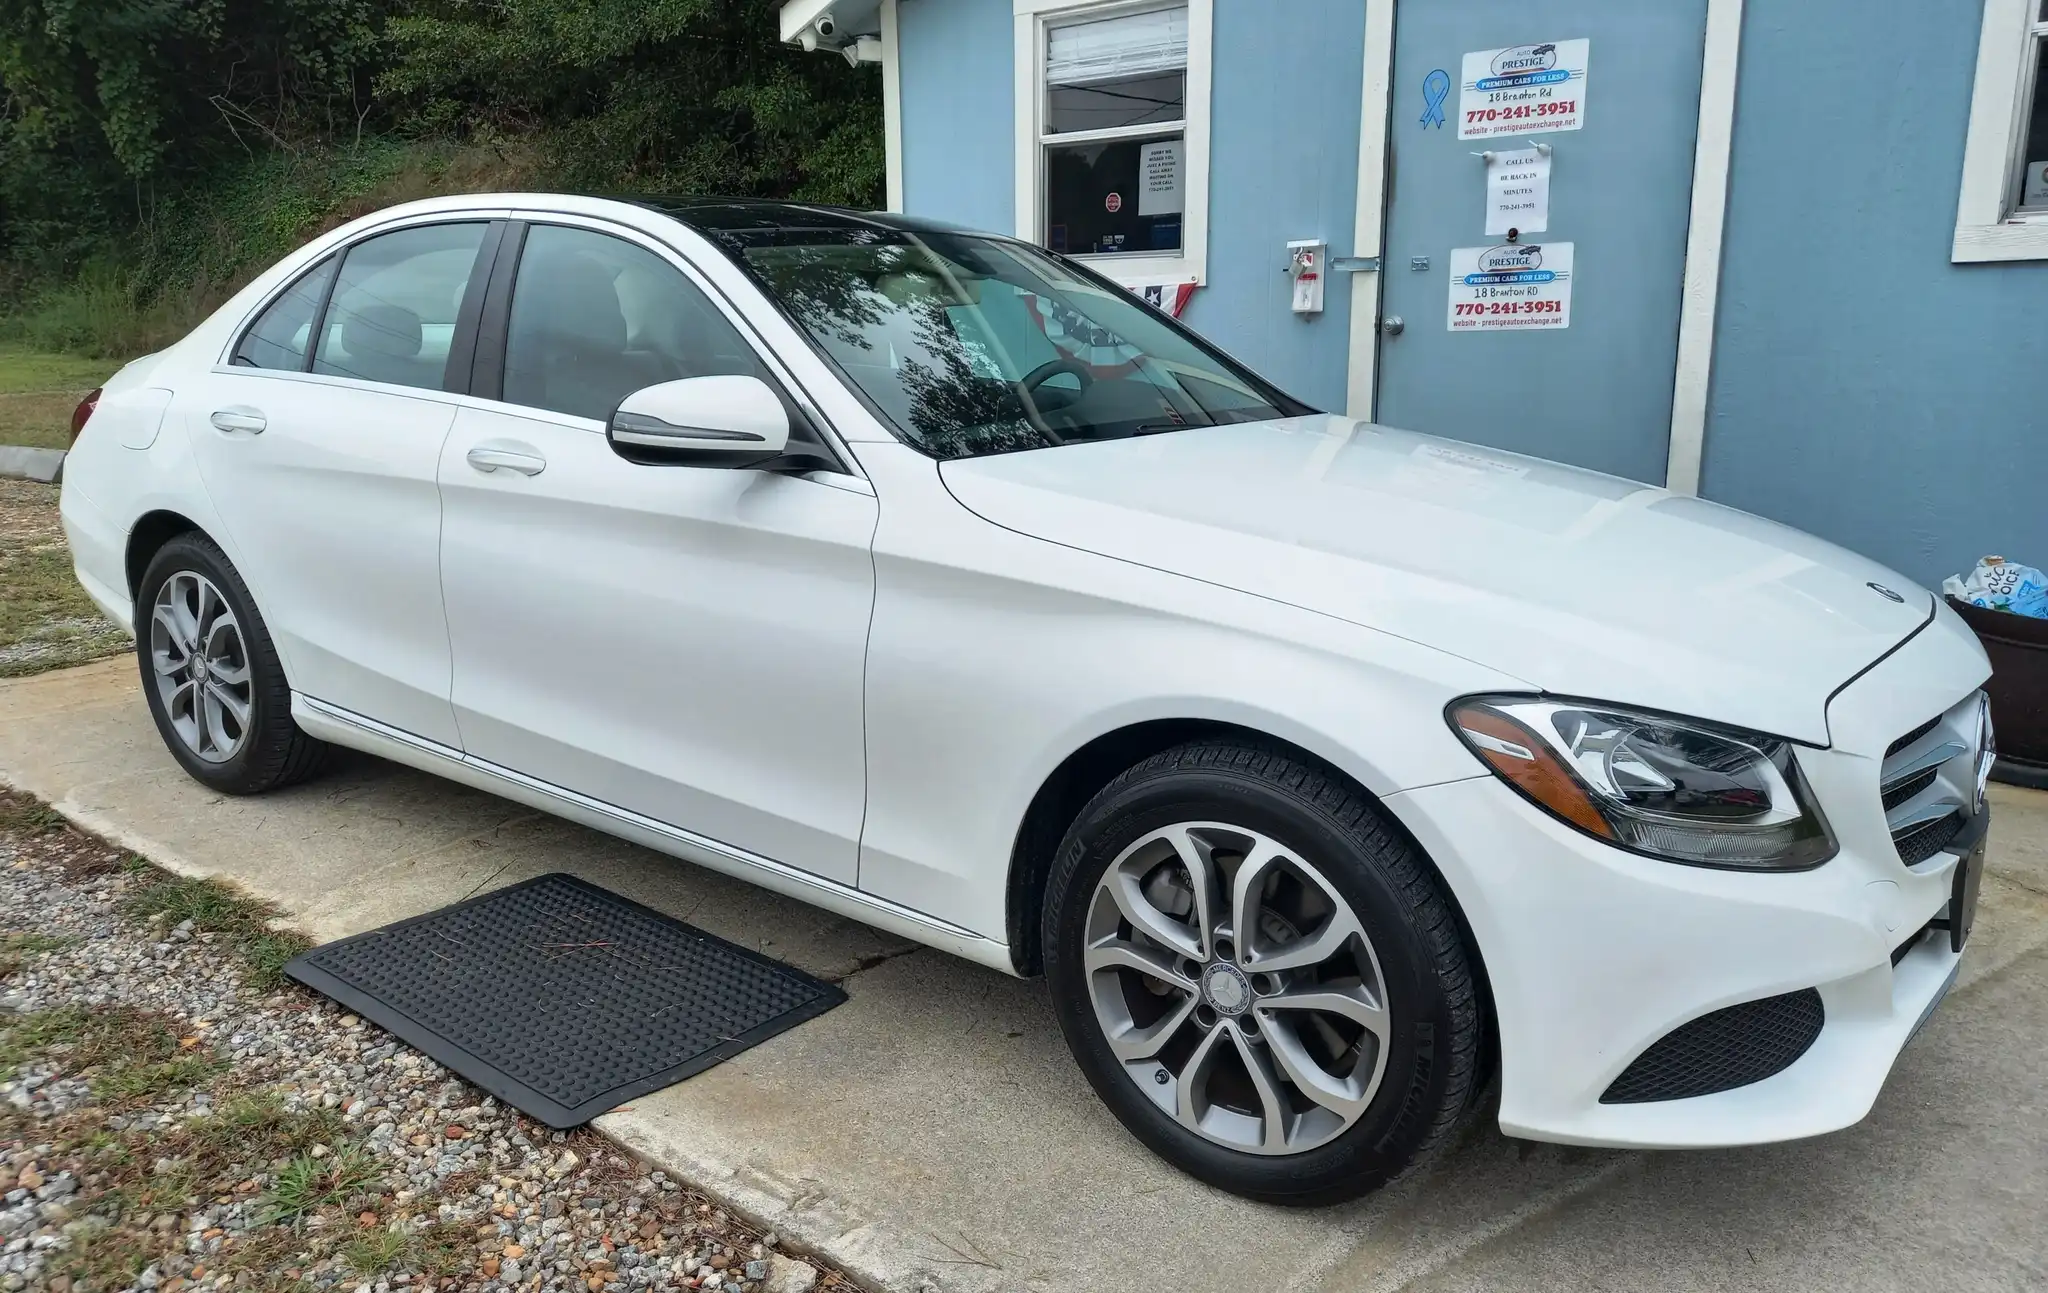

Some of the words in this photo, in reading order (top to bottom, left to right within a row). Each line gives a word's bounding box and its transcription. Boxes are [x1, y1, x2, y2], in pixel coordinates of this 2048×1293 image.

[1502, 57, 1544, 69] PRESTIGE
[1481, 77, 1513, 89] PREMIUM
[1514, 76, 1531, 85] CARS
[1532, 74, 1546, 83] FOR
[1548, 72, 1565, 81] LESS
[1489, 92, 1500, 102] 18
[1540, 88, 1552, 98] Rd
[1466, 100, 1576, 124] 770-241-3951
[1464, 124, 1488, 136] website
[1493, 118, 1576, 134] prestigeautoexchange.net
[1503, 188, 1533, 196] MINUTES
[1500, 202, 1535, 210] 770-241-3951
[1489, 256, 1530, 266] PRESTIGE
[1469, 276, 1501, 284] PREMIUM
[1502, 274, 1518, 282] CARS
[1474, 288, 1488, 299] 18
[1527, 286, 1538, 296] RD
[1456, 300, 1561, 316] 770-241-3951
[1481, 316, 1562, 328] prestigeautoexchange.net
[1211, 965, 1246, 984] MERCEDES
